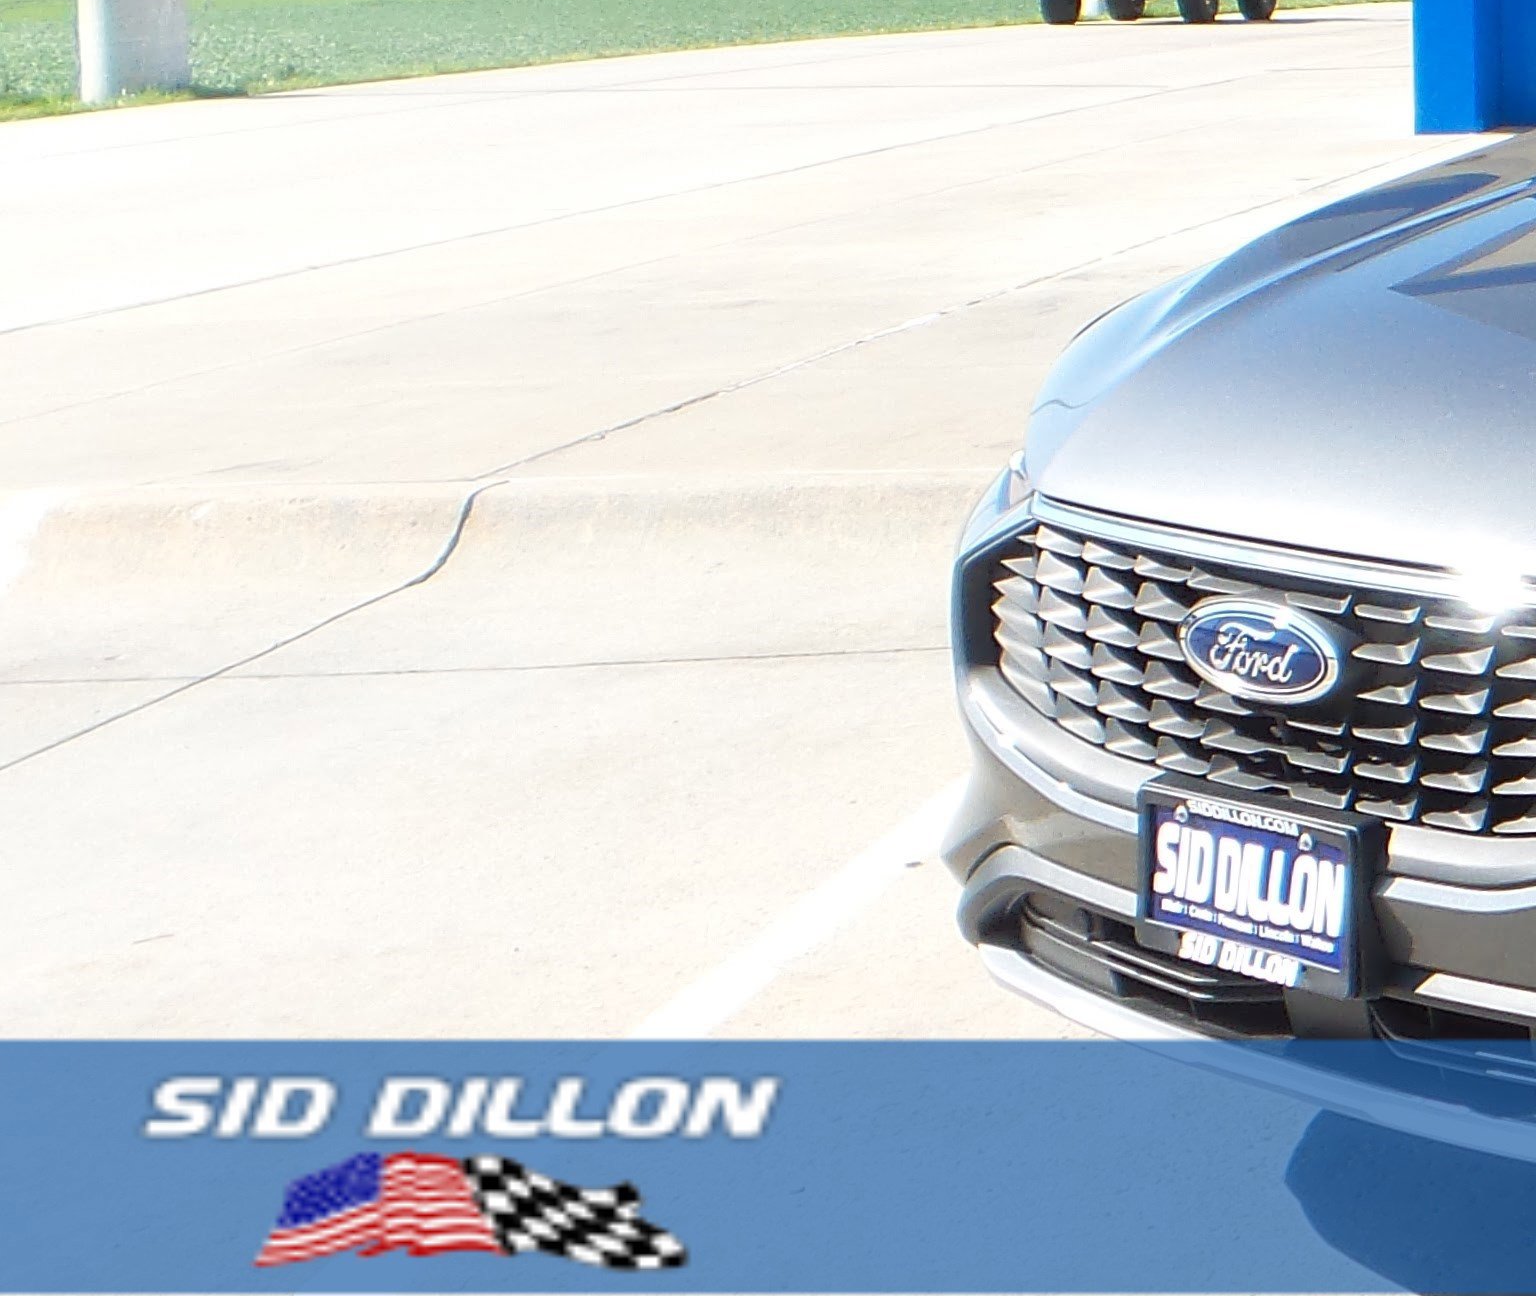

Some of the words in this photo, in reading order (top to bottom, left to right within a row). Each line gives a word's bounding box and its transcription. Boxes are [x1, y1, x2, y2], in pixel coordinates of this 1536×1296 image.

[1209, 621, 1299, 684] Ford
[1186, 799, 1300, 837] SIDDILLON.COM
[1152, 820, 1214, 904] SID
[1214, 836, 1346, 938] DILLON
[1178, 931, 1218, 965] SID
[1217, 939, 1301, 988] DILLON
